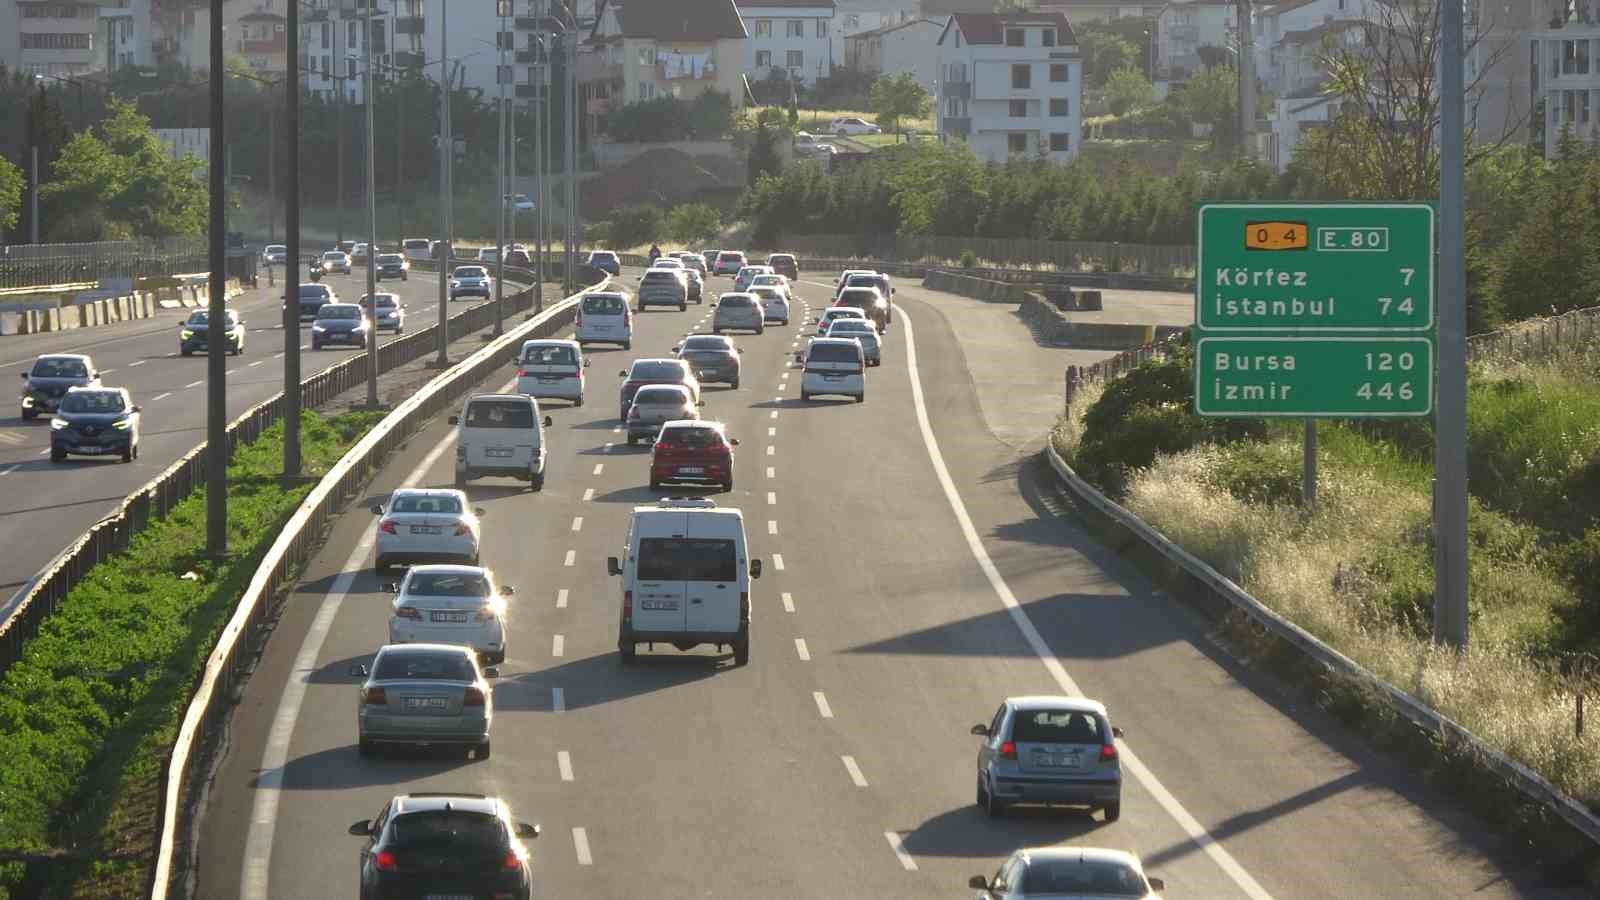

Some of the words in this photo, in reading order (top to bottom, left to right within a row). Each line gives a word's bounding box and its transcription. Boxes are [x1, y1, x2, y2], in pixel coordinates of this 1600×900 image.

[1216, 268, 1307, 286] Körfez
[1400, 268, 1415, 286] 7
[1216, 294, 1334, 315] İstanbul
[1378, 298, 1414, 315] 74
[1215, 353, 1296, 370] Bursa
[1365, 353, 1414, 370] 120
[1215, 378, 1291, 400] İzmir
[1357, 382, 1414, 400] 446
